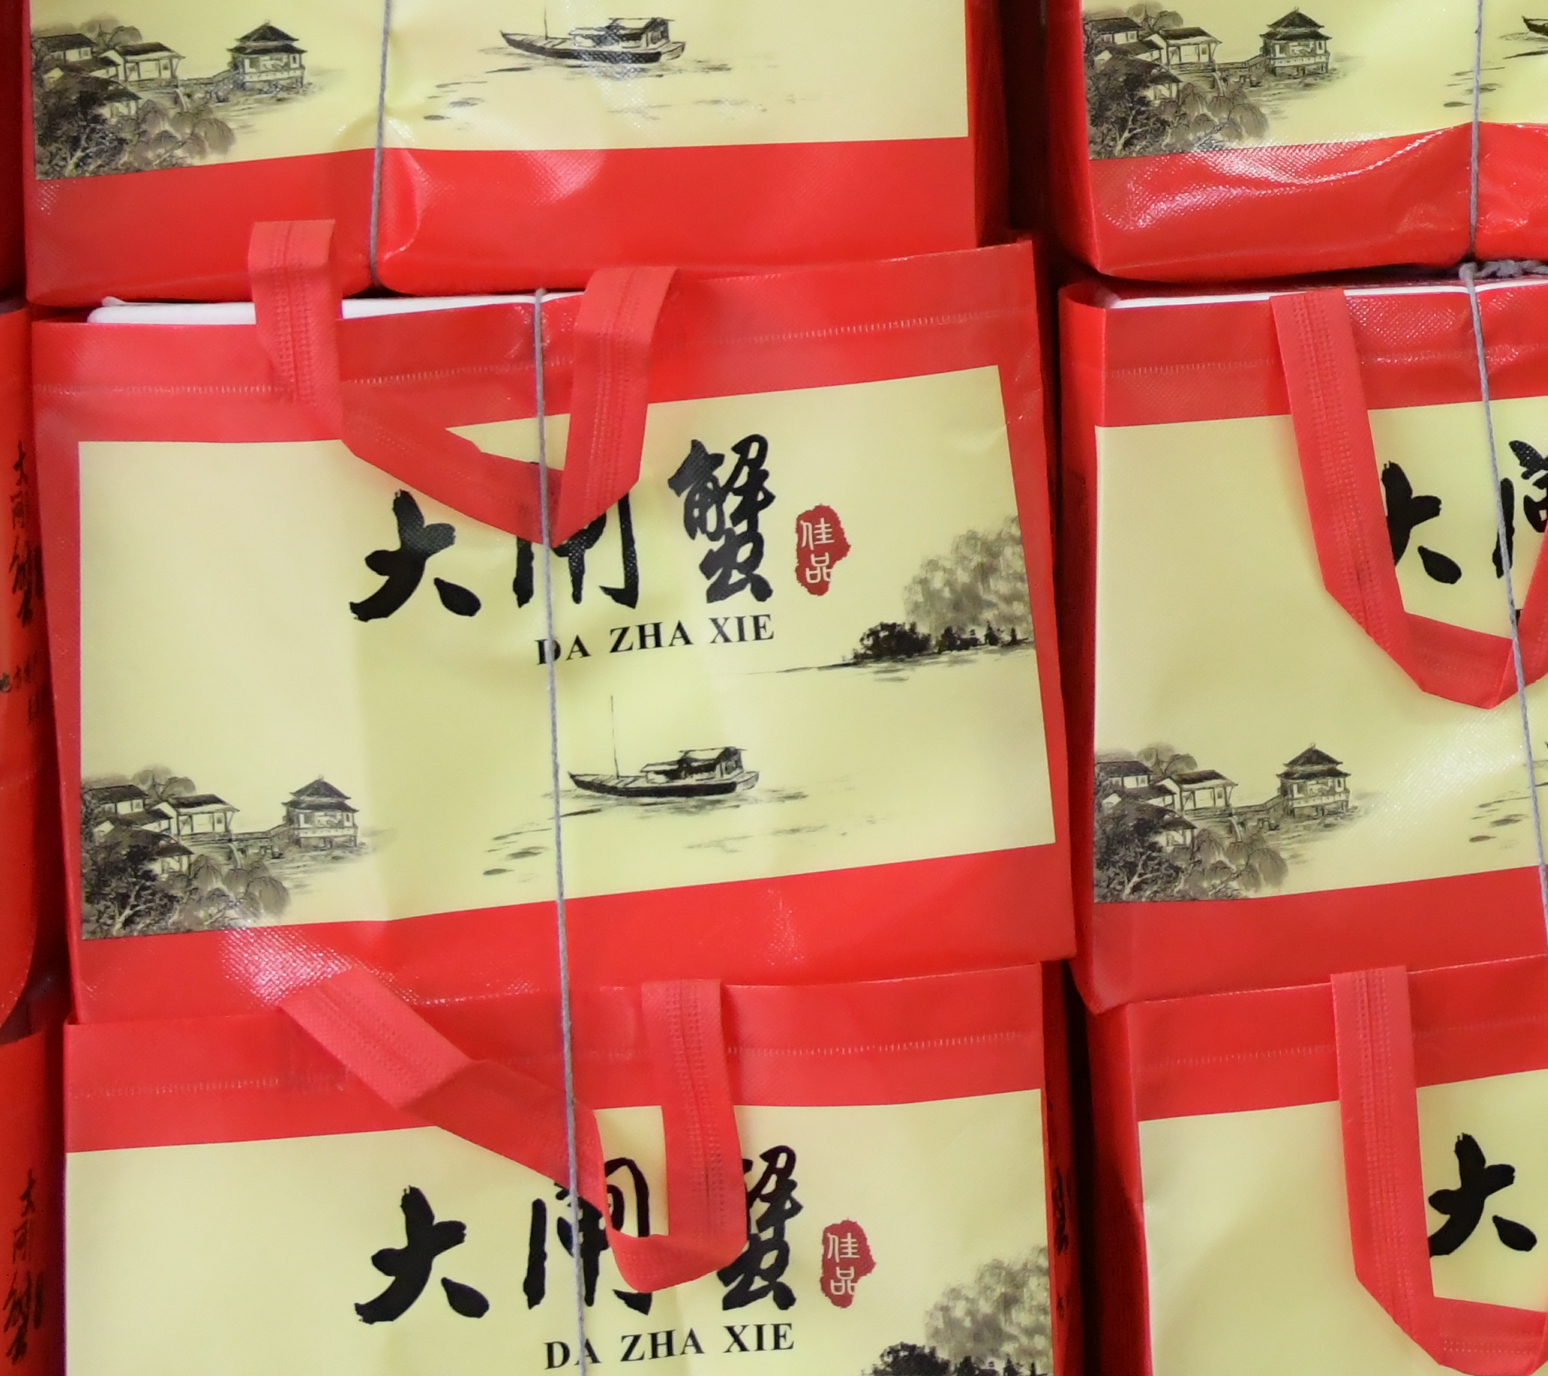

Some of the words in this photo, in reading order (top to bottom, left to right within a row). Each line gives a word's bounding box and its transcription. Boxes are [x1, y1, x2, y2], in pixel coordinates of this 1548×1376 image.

[801, 520, 834, 584] 佳品
[536, 638, 591, 667] DA
[610, 624, 694, 655] ZHA
[708, 613, 775, 645] XIE
[827, 1231, 861, 1296] 佳品
[545, 1339, 602, 1371] DA
[620, 1329, 704, 1360] ZHA
[724, 1323, 795, 1354] XIE
